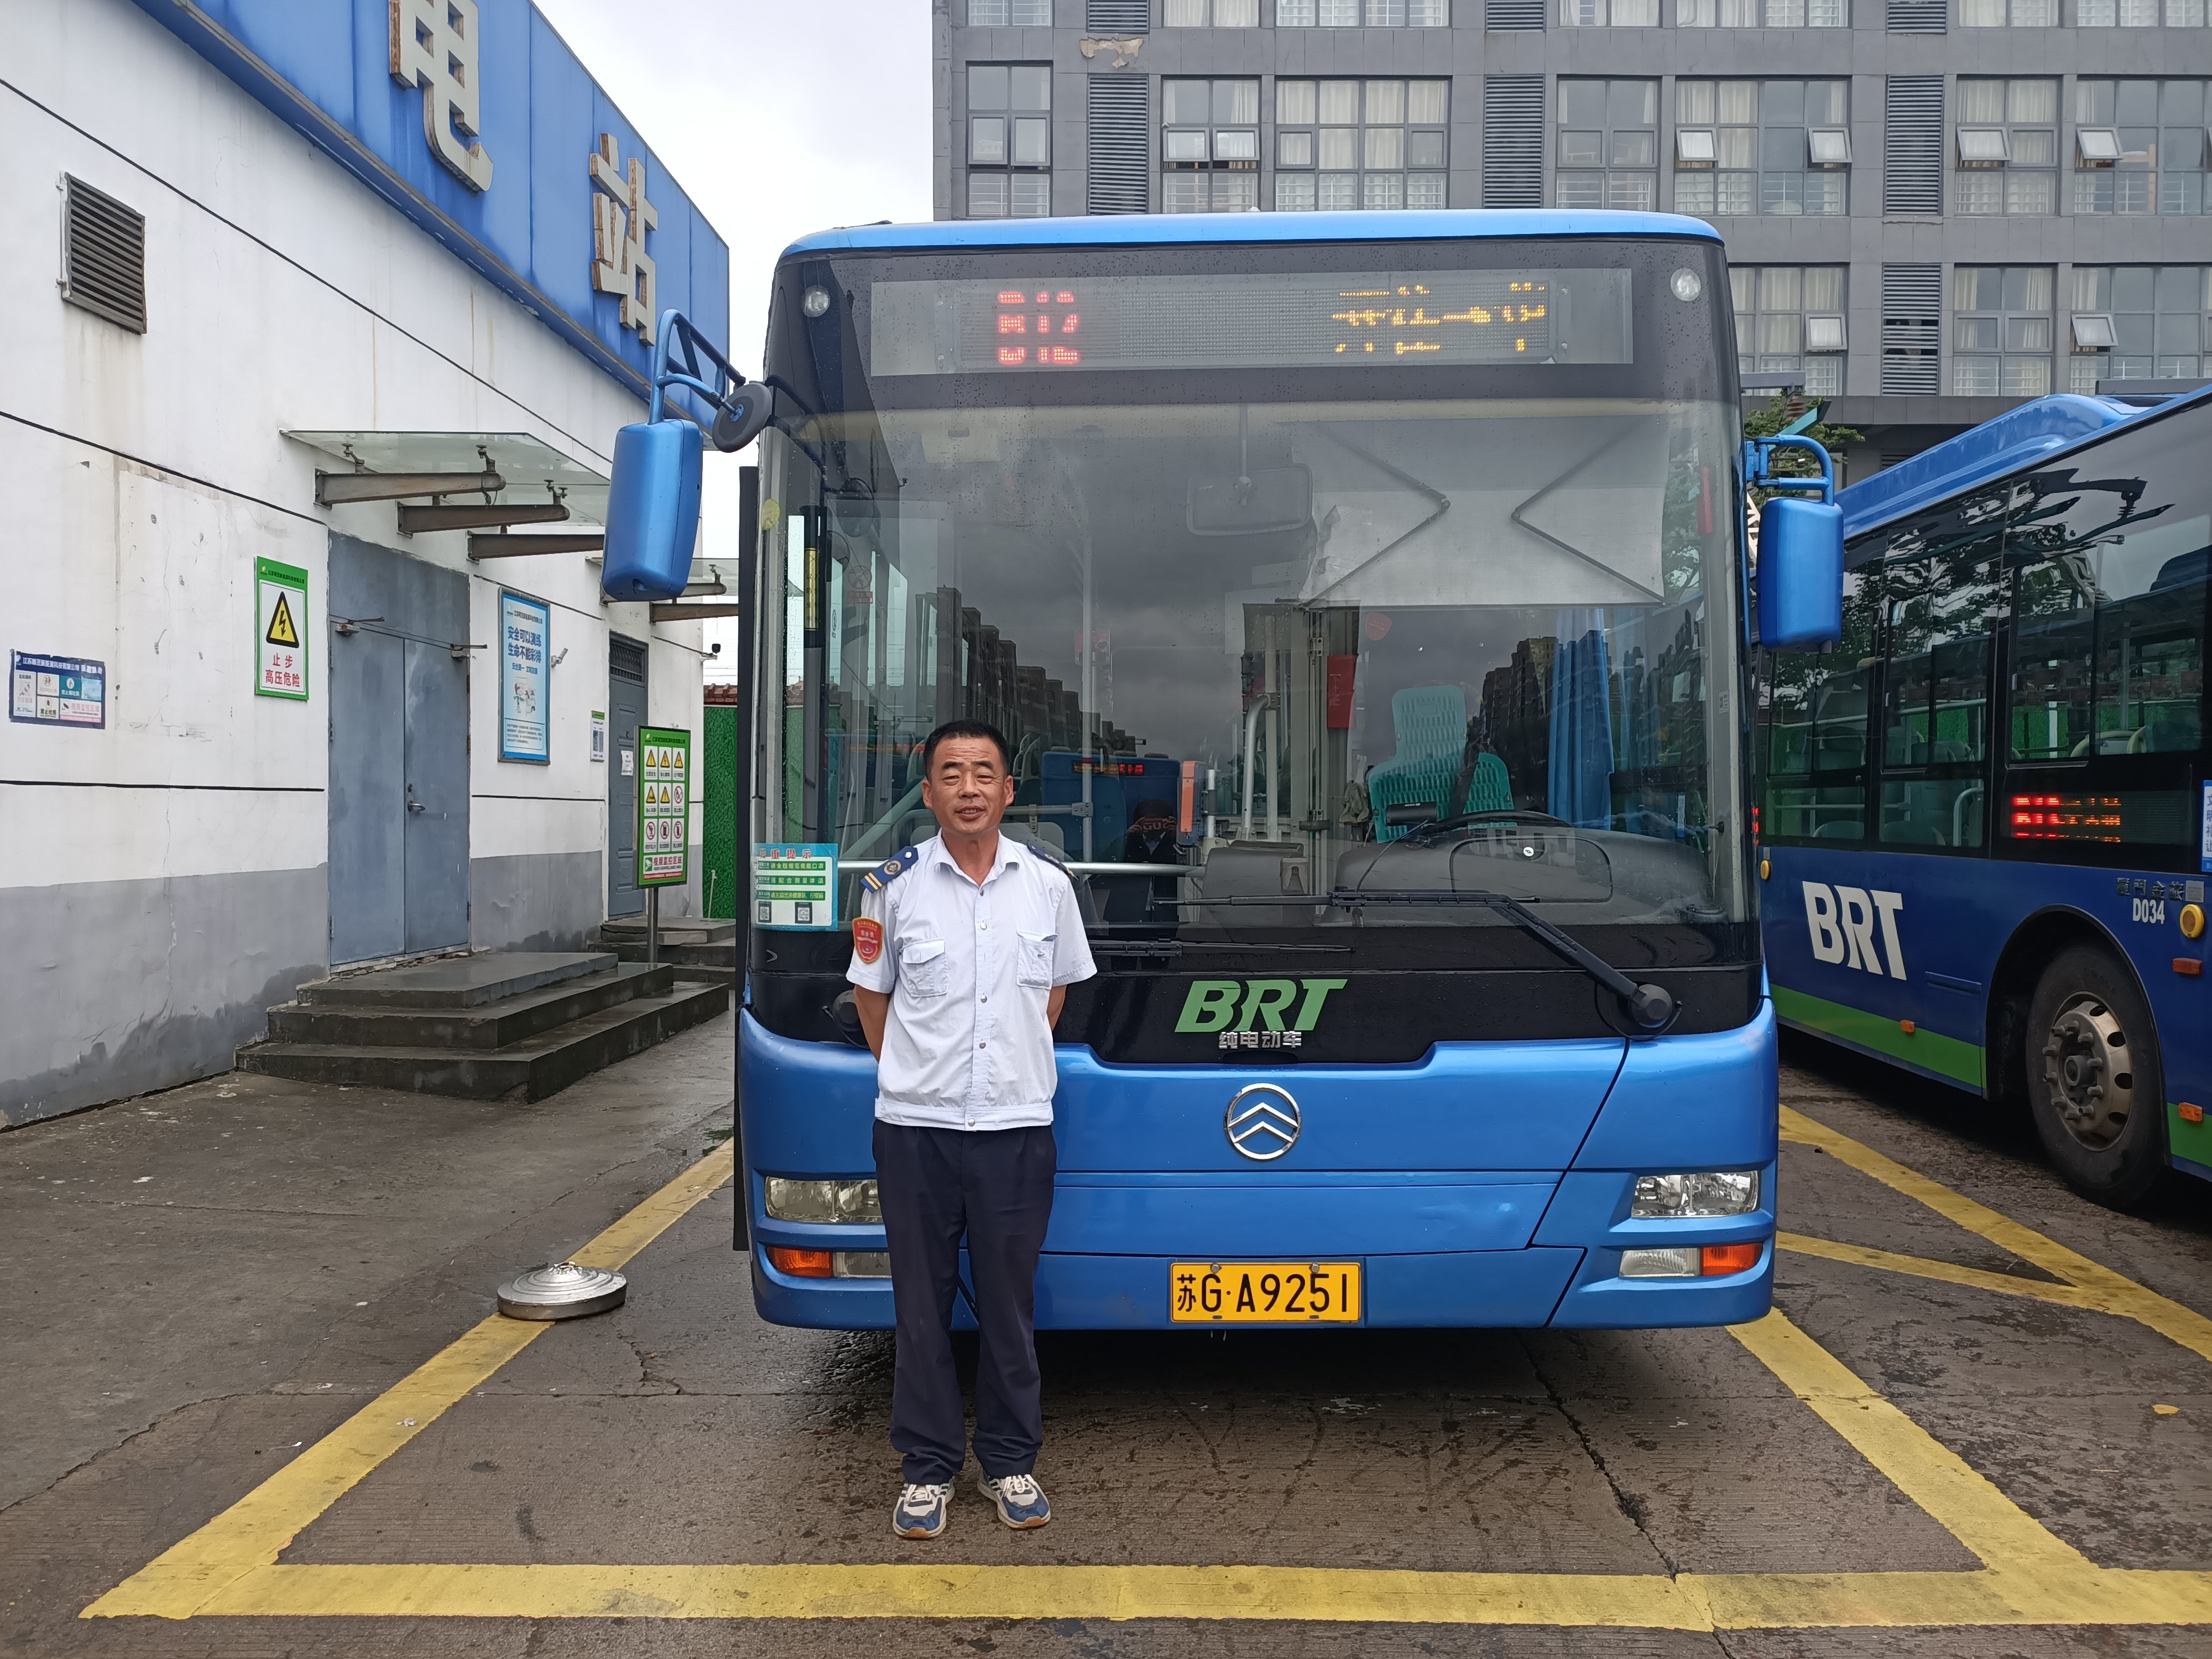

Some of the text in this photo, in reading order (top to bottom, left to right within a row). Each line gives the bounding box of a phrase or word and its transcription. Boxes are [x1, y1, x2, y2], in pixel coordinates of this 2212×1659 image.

[508, 625, 542, 648] 安全可以演练
[273, 653, 293, 668] 止步
[265, 669, 300, 687] 高压危险
[2132, 899, 2165, 925] D034
[1802, 880, 1907, 981] BRT
[1175, 979, 1349, 1033] BRT
[1218, 1031, 1302, 1049] 纯电动车
